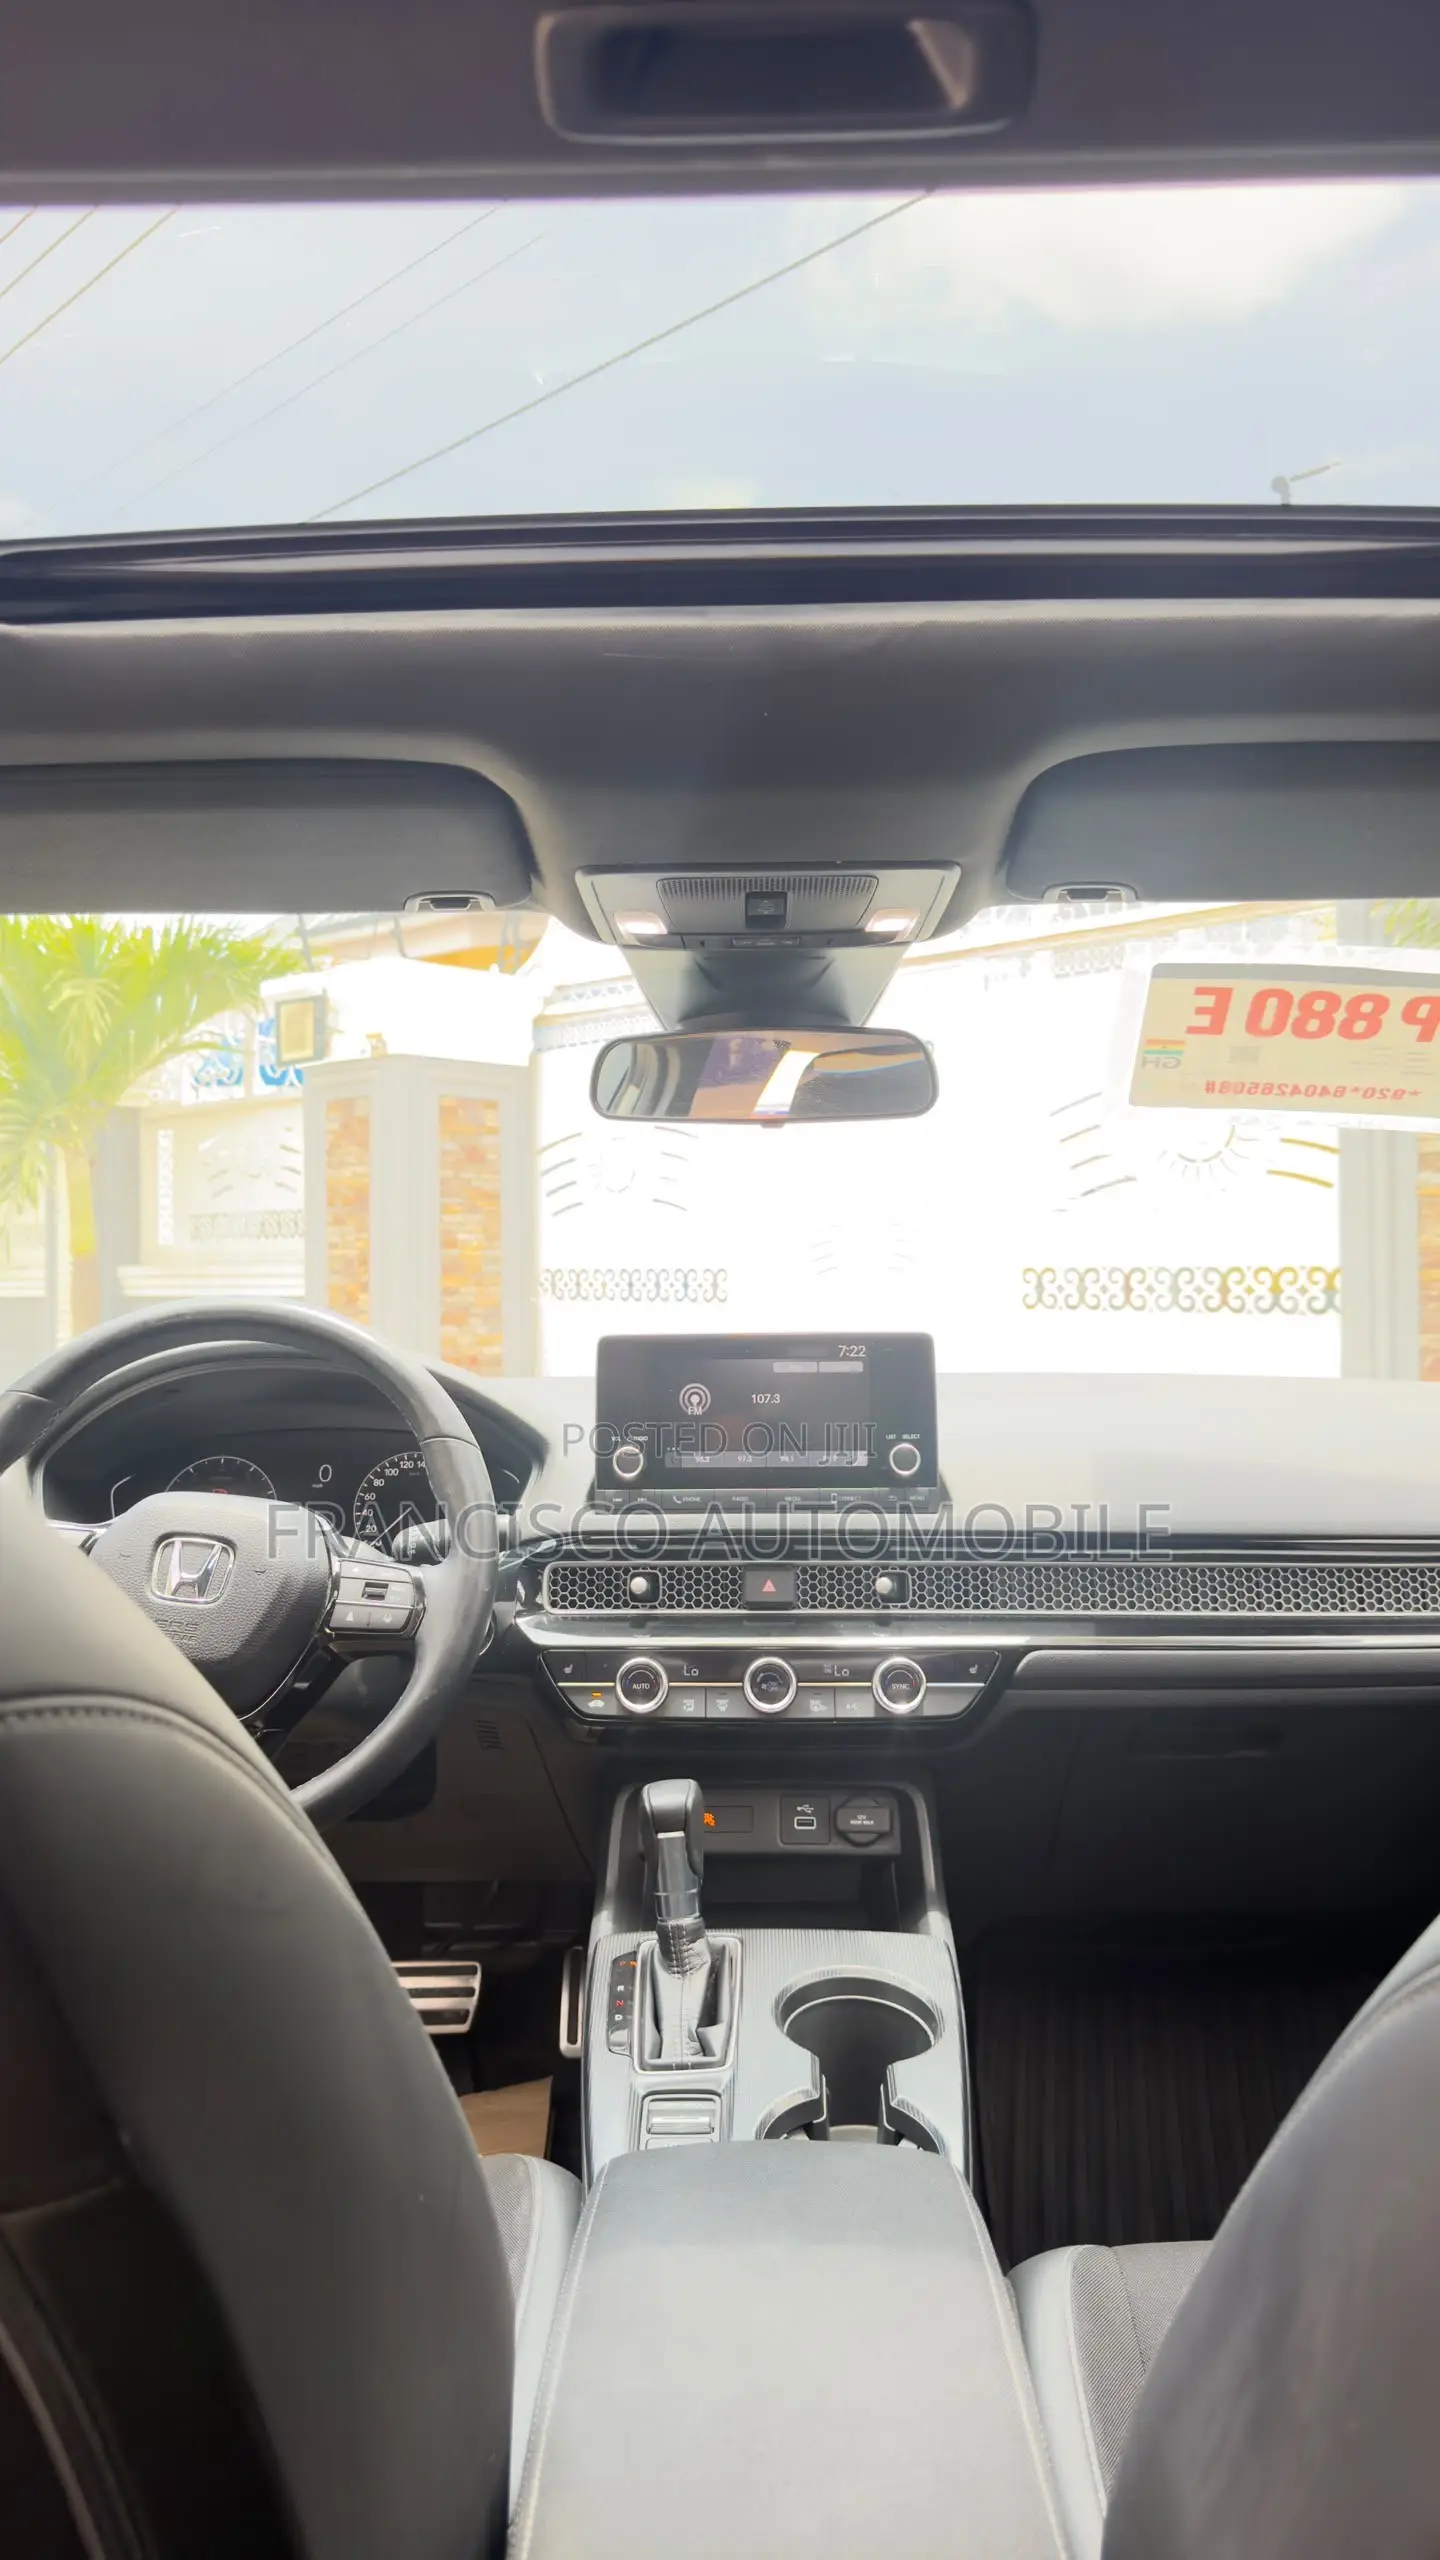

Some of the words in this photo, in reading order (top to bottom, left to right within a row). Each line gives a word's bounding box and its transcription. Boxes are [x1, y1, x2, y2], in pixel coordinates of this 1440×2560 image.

[838, 1345, 866, 1358] 7:22
[751, 1394, 780, 1404] 107.3
[687, 1407, 703, 1415] FM
[400, 1461, 414, 1469] 120
[319, 1464, 332, 1482] 0
[384, 1468, 399, 1476] 100
[373, 1479, 384, 1487] 80
[364, 1492, 376, 1500] 60
[362, 1509, 373, 1517] 40
[365, 1524, 377, 1533] 20
[683, 1664, 699, 1676] Lo
[834, 1665, 850, 1677] Lo
